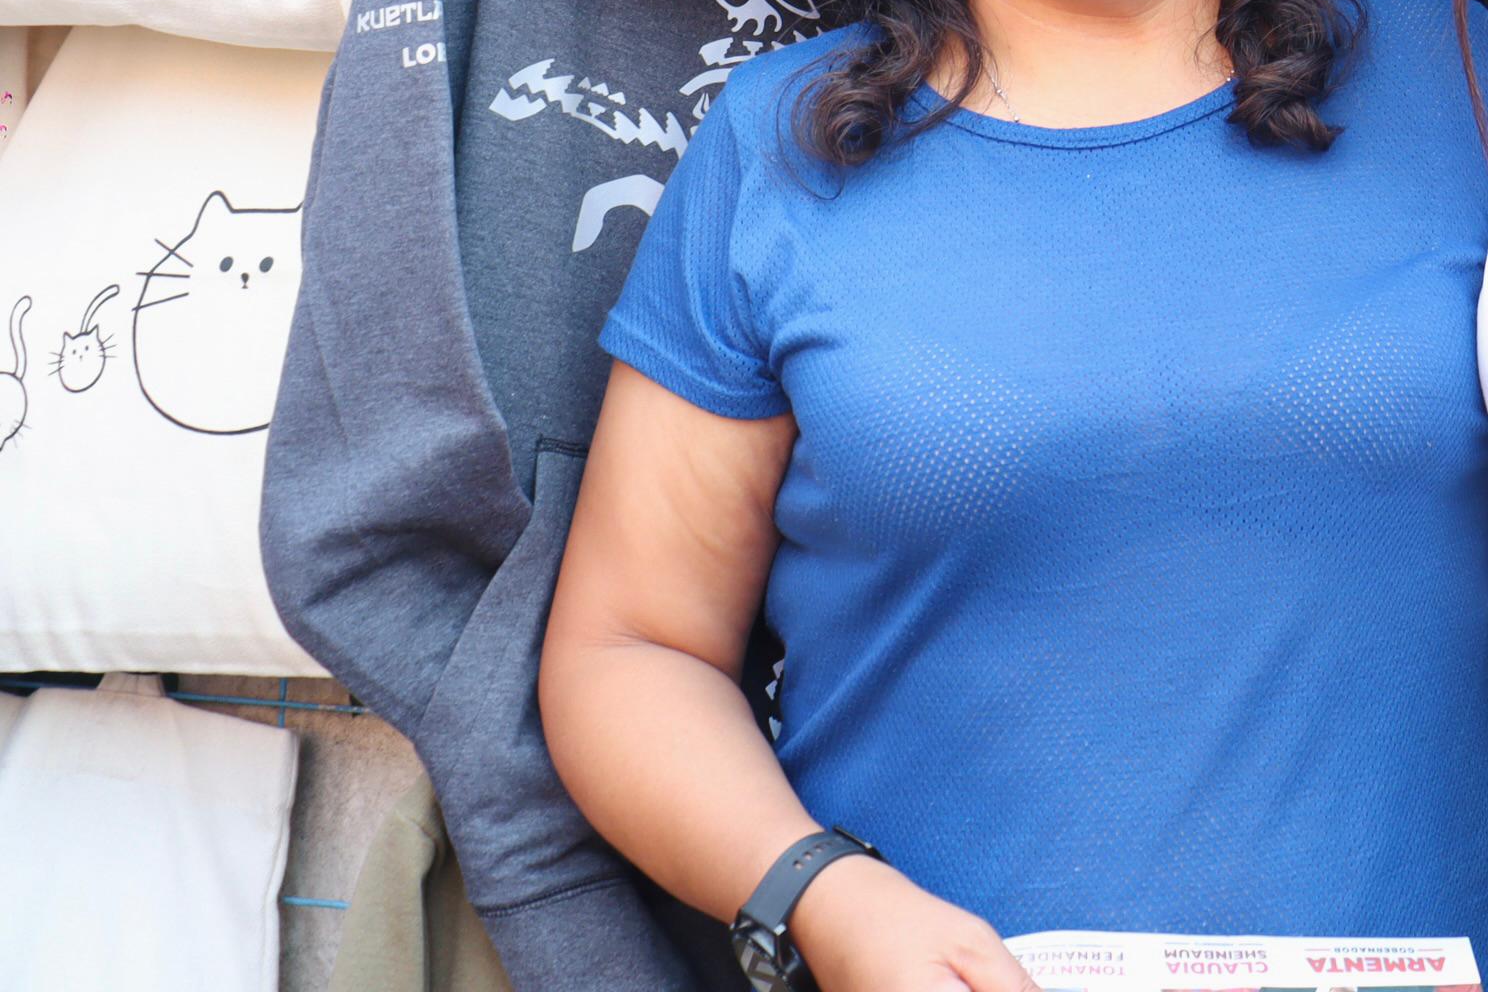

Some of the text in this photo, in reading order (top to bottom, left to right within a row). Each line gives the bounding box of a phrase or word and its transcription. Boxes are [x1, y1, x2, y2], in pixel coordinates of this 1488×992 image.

[1164, 948, 1268, 960] SHEINBAUM
[1165, 961, 1269, 975] CLAUDIA
[1306, 956, 1446, 973] ARMENTA
